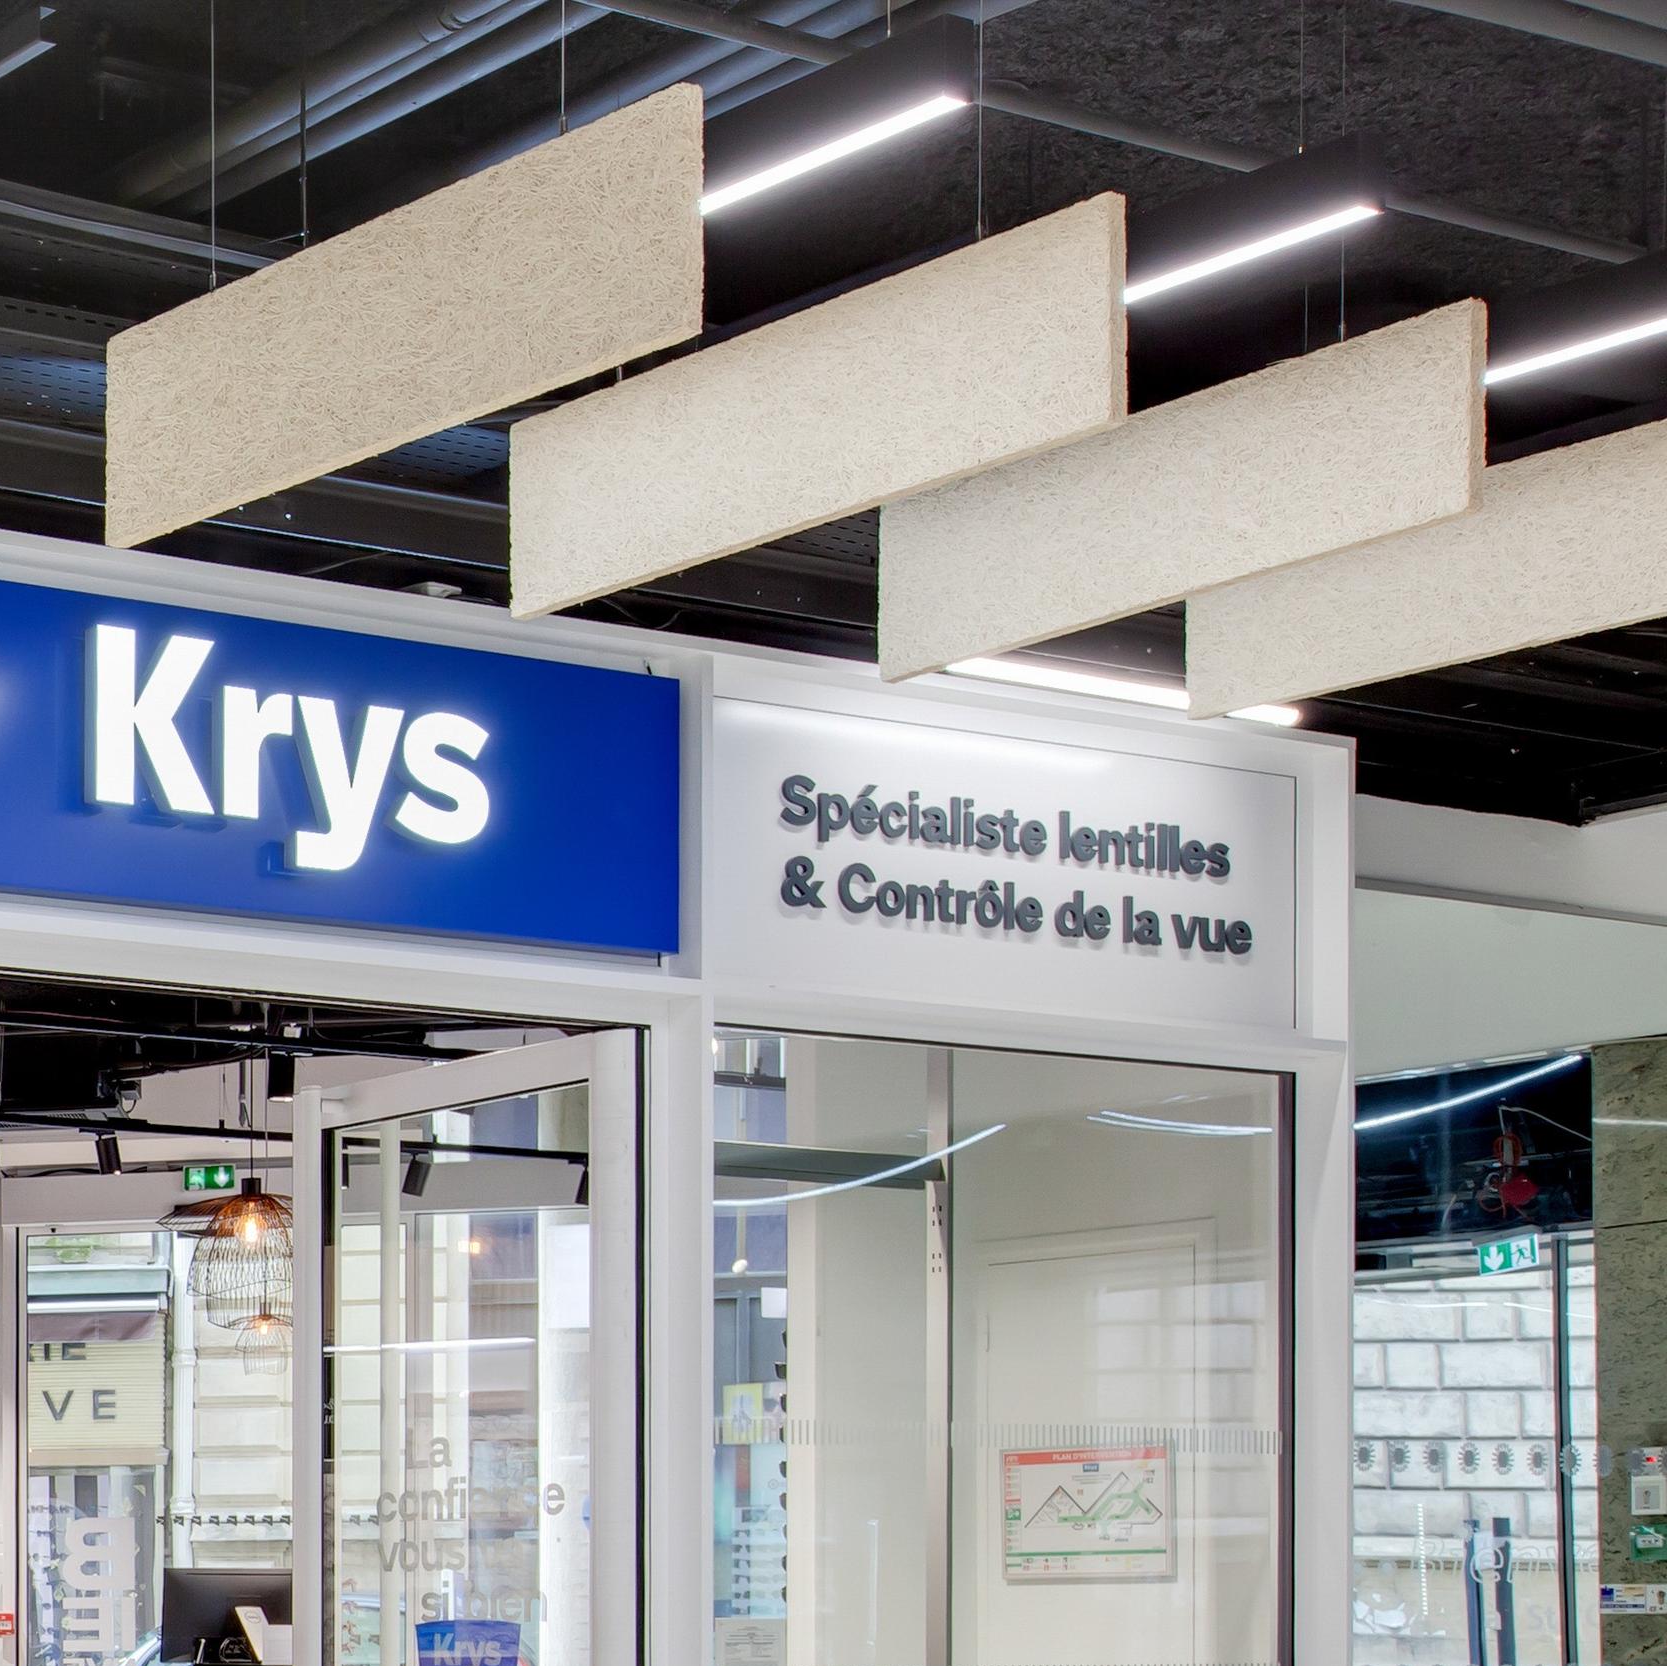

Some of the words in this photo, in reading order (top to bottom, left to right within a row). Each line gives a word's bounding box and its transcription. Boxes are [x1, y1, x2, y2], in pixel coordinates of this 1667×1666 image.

[85, 624, 490, 871] Krys
[780, 774, 1047, 857] Spécialiste
[1058, 810, 1231, 878] lentilles
[780, 856, 826, 909] &
[838, 862, 1044, 933] Contrôle
[1055, 891, 1111, 940] de
[1123, 896, 1162, 946] la
[1171, 914, 1253, 955] vue
[407, 1430, 452, 1470] La
[377, 1540, 465, 1573] vous
[421, 1579, 454, 1622] si
